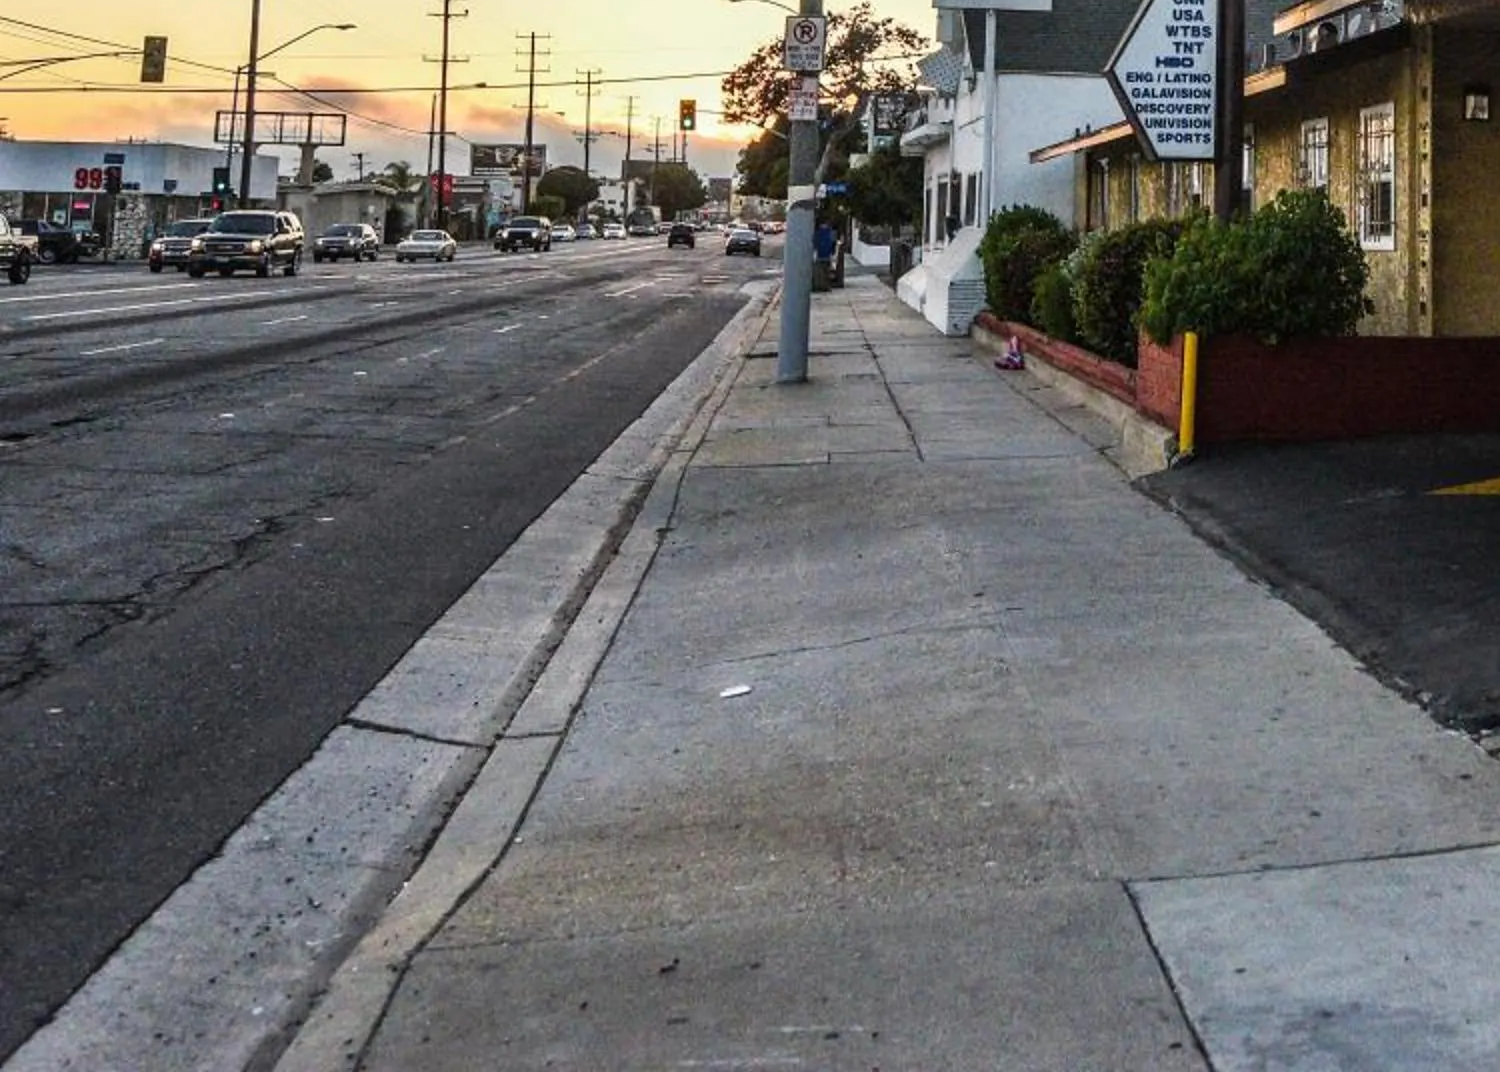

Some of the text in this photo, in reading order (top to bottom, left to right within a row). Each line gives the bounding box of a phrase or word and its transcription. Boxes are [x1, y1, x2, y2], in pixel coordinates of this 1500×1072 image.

[1173, 9, 1204, 22] USA
[1165, 25, 1213, 38] WTBS
[1173, 42, 1205, 55] TNT
[1155, 57, 1195, 69] HBO
[1125, 71, 1154, 84] ENG
[1165, 72, 1212, 84] LATINO
[1131, 87, 1212, 100] GALAVISION
[1135, 102, 1212, 115] DISCOVERY
[1145, 117, 1212, 129] UNIVISION
[1157, 132, 1212, 144] SPORTS
